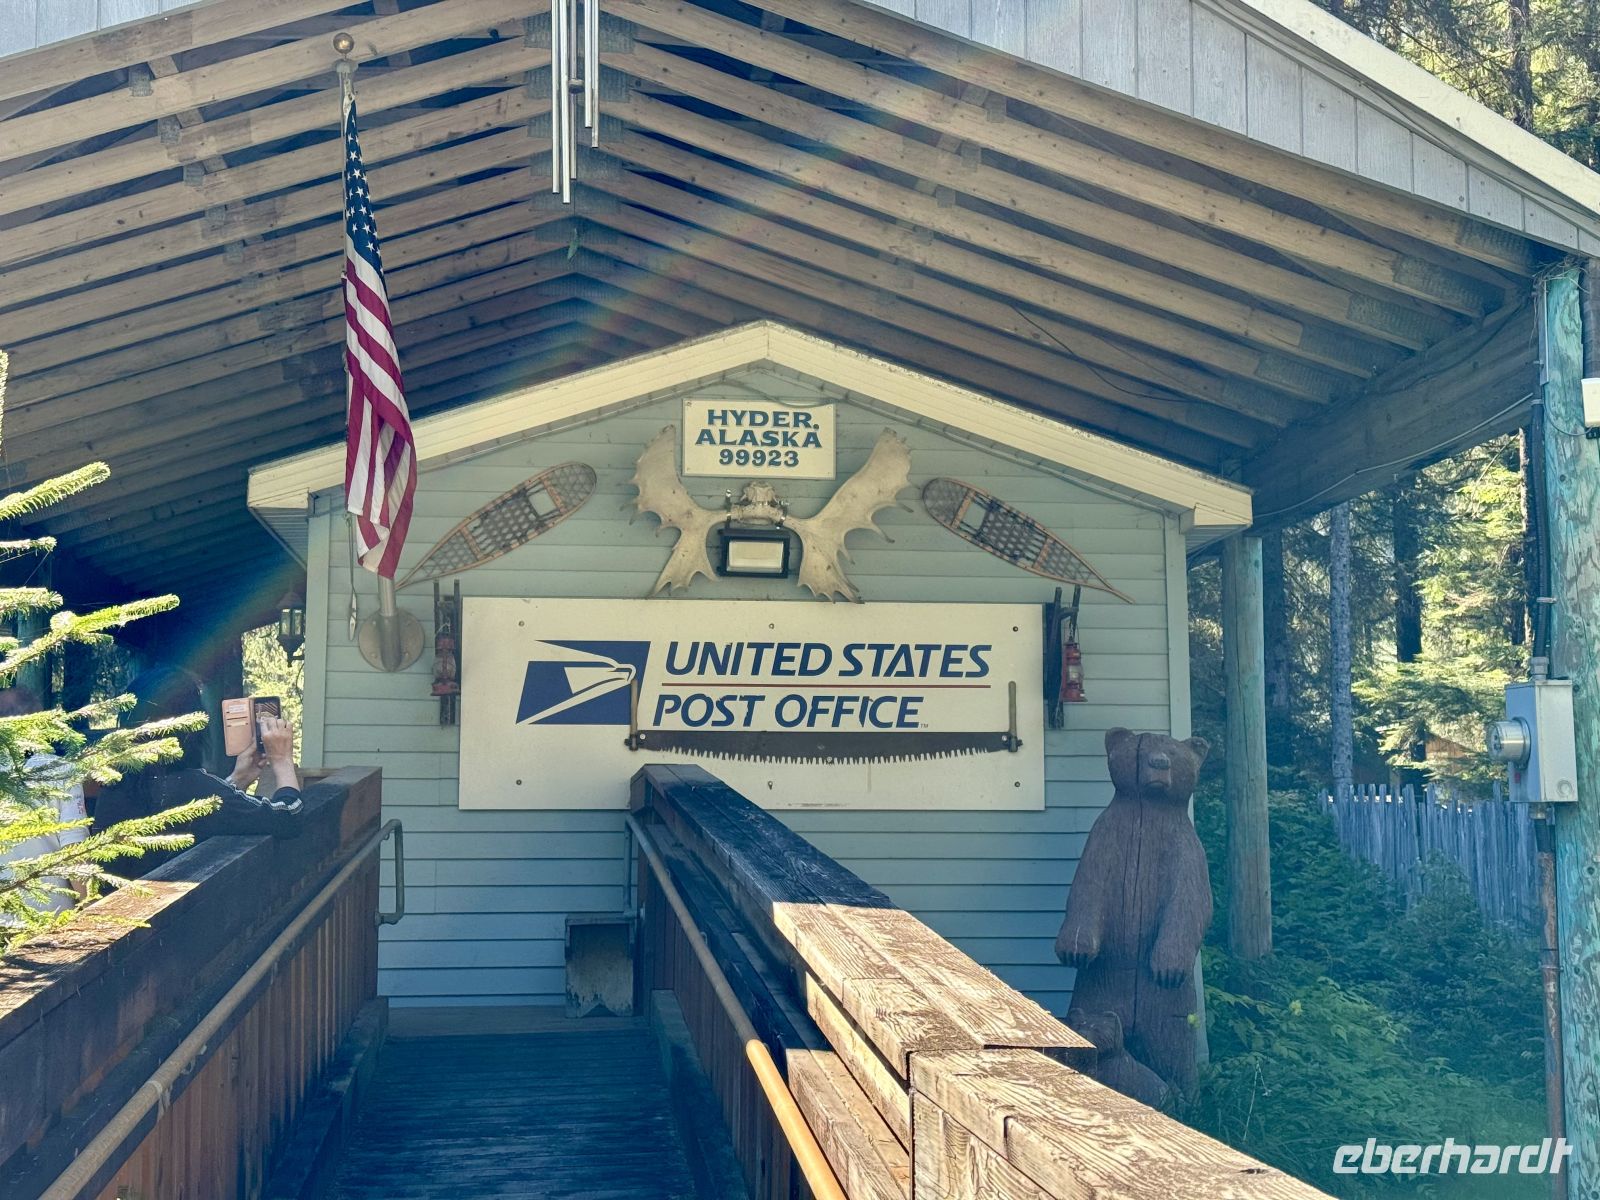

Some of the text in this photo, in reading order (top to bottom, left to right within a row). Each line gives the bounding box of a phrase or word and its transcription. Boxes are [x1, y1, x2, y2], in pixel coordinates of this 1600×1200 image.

[695, 428, 822, 448] ALASKA
[718, 448, 800, 467] 99923
[665, 641, 992, 678] UNITED STATES
[652, 693, 766, 728] POST
[774, 693, 924, 729] OFFICE
